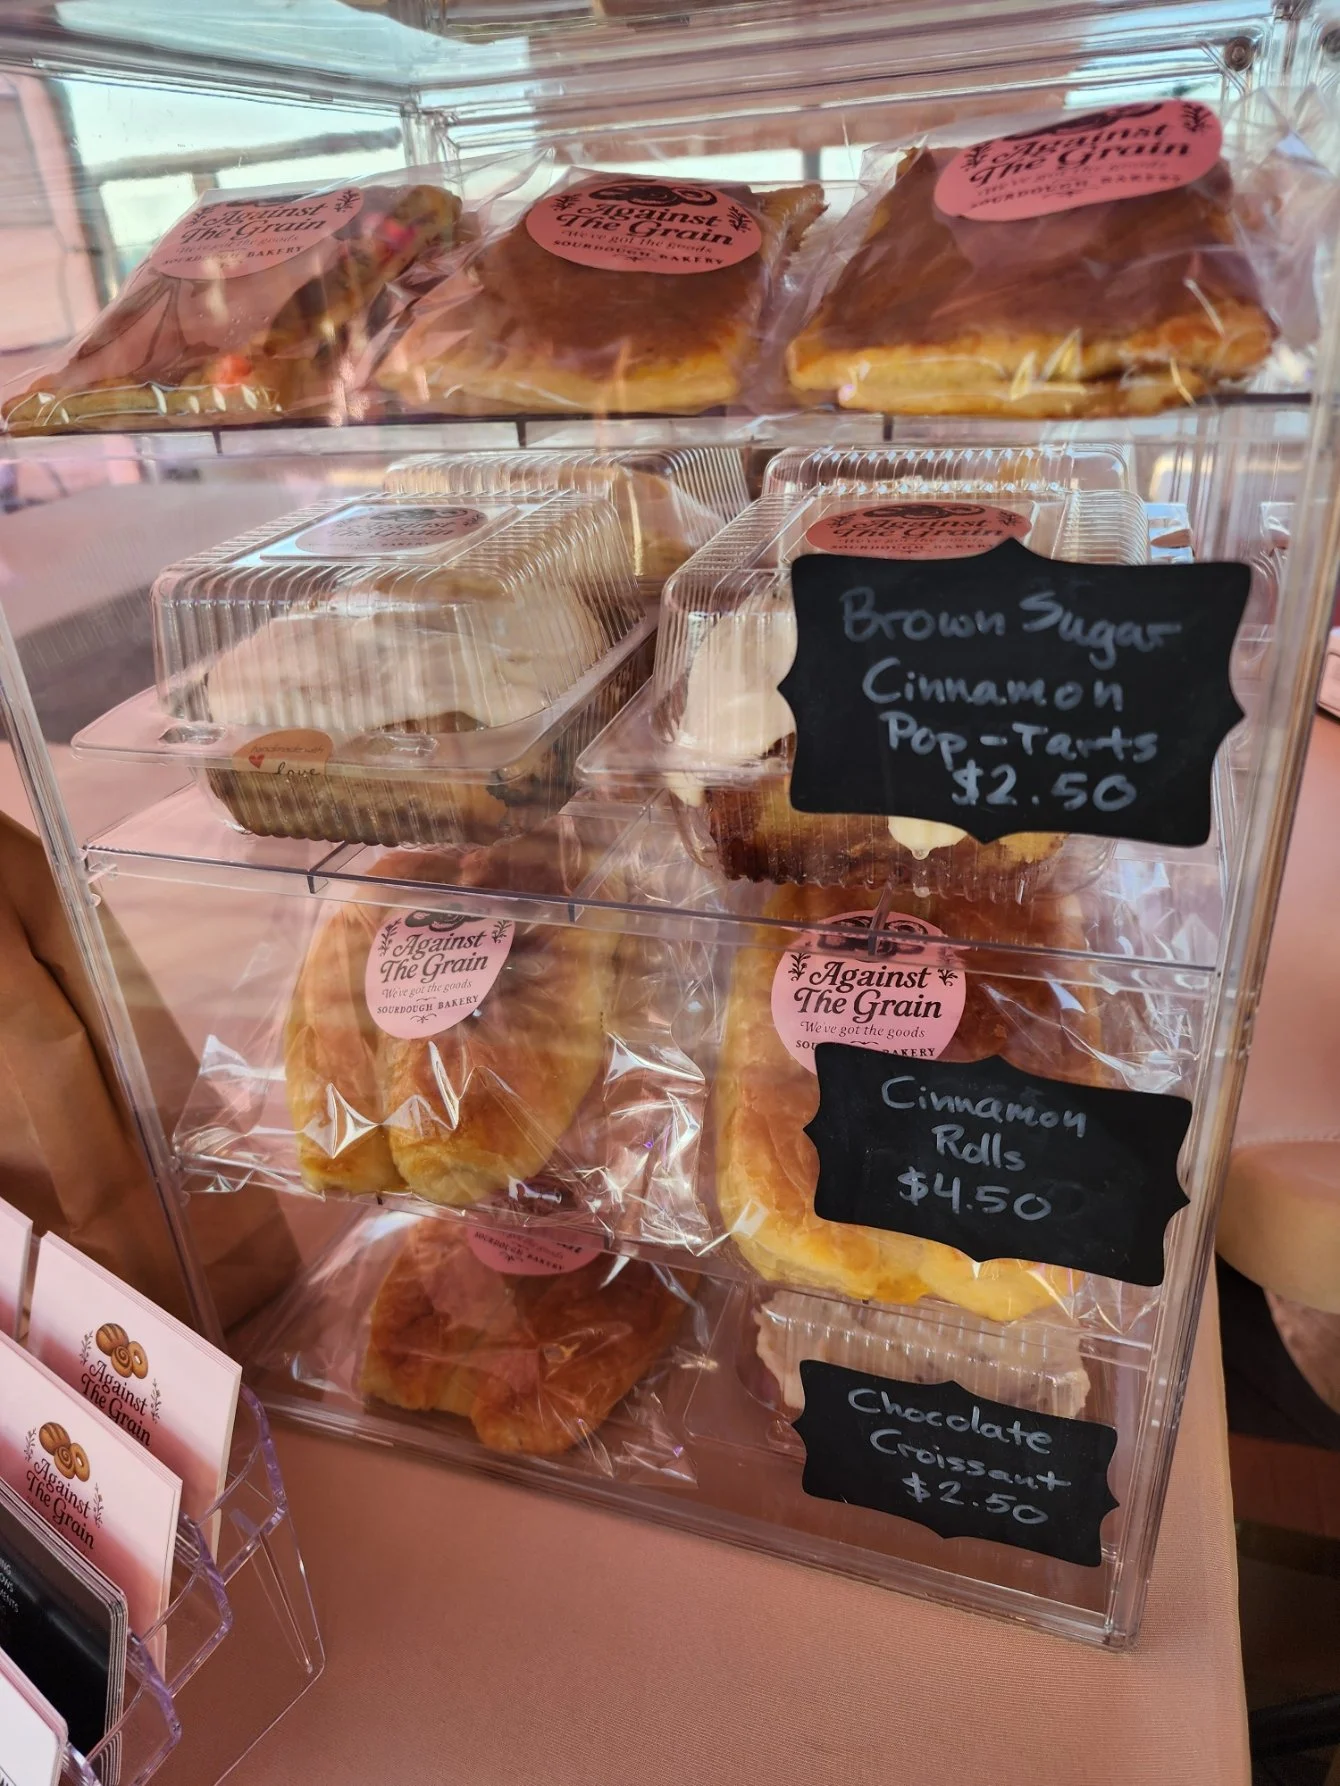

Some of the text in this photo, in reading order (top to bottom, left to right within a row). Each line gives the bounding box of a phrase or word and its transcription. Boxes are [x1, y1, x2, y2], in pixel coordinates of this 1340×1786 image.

[991, 124, 1168, 164] Against
[969, 141, 1190, 186] The Grain
[181, 218, 327, 245] The Grain
[203, 203, 328, 226] Against
[555, 213, 733, 246] The Grain
[576, 203, 722, 227] Against
[246, 245, 305, 258] BAKERY
[659, 253, 724, 265] BAKERY
[832, 527, 1003, 539] The Grain
[852, 519, 991, 530] Against
[840, 587, 1182, 670] Brown Sugar
[862, 657, 1124, 712] Cinnamon
[273, 761, 321, 776] love
[951, 759, 1138, 812] $2.50
[393, 931, 487, 960] Against
[380, 952, 489, 984] The Grain
[809, 961, 932, 994] Against
[376, 995, 480, 1014] SOURDOUGH BAKERY
[382, 979, 473, 1000] We've got the goods
[793, 987, 943, 1024] The Grain
[800, 1021, 925, 1038] We've got the goods
[881, 1075, 1086, 1138] Cinnamon
[931, 1124, 1026, 1171] Rolls
[897, 1166, 1052, 1221] $4.50
[89, 1360, 148, 1416] Against
[81, 1373, 150, 1446] The Grain
[848, 1388, 1052, 1454] Chocolate
[869, 1428, 1071, 1491] Croissant
[34, 1458, 91, 1519] Against
[901, 1471, 1048, 1525] $2.50
[26, 1470, 94, 1549] The Grain
